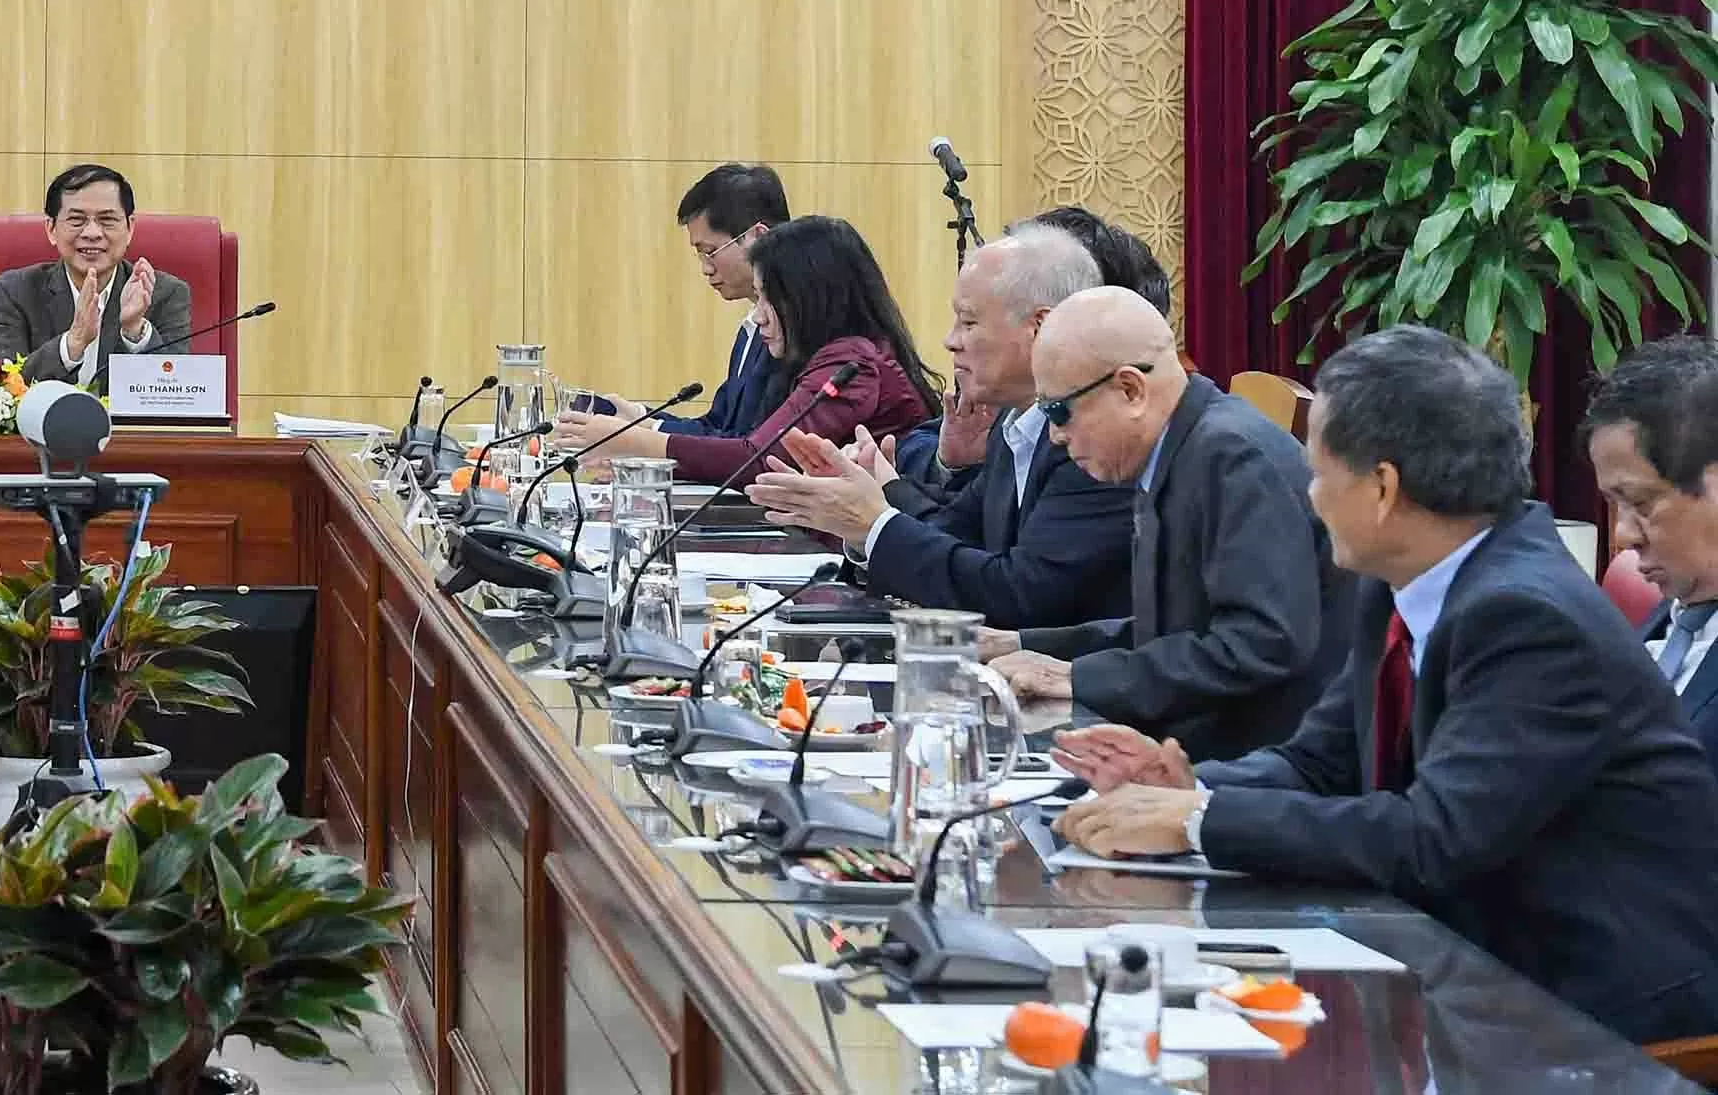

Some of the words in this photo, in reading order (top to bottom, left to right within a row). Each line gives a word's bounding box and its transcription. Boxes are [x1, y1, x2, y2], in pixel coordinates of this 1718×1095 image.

[129, 383, 146, 393] BÙI
[149, 385, 183, 393] THANH
[185, 385, 206, 393] SƠN
